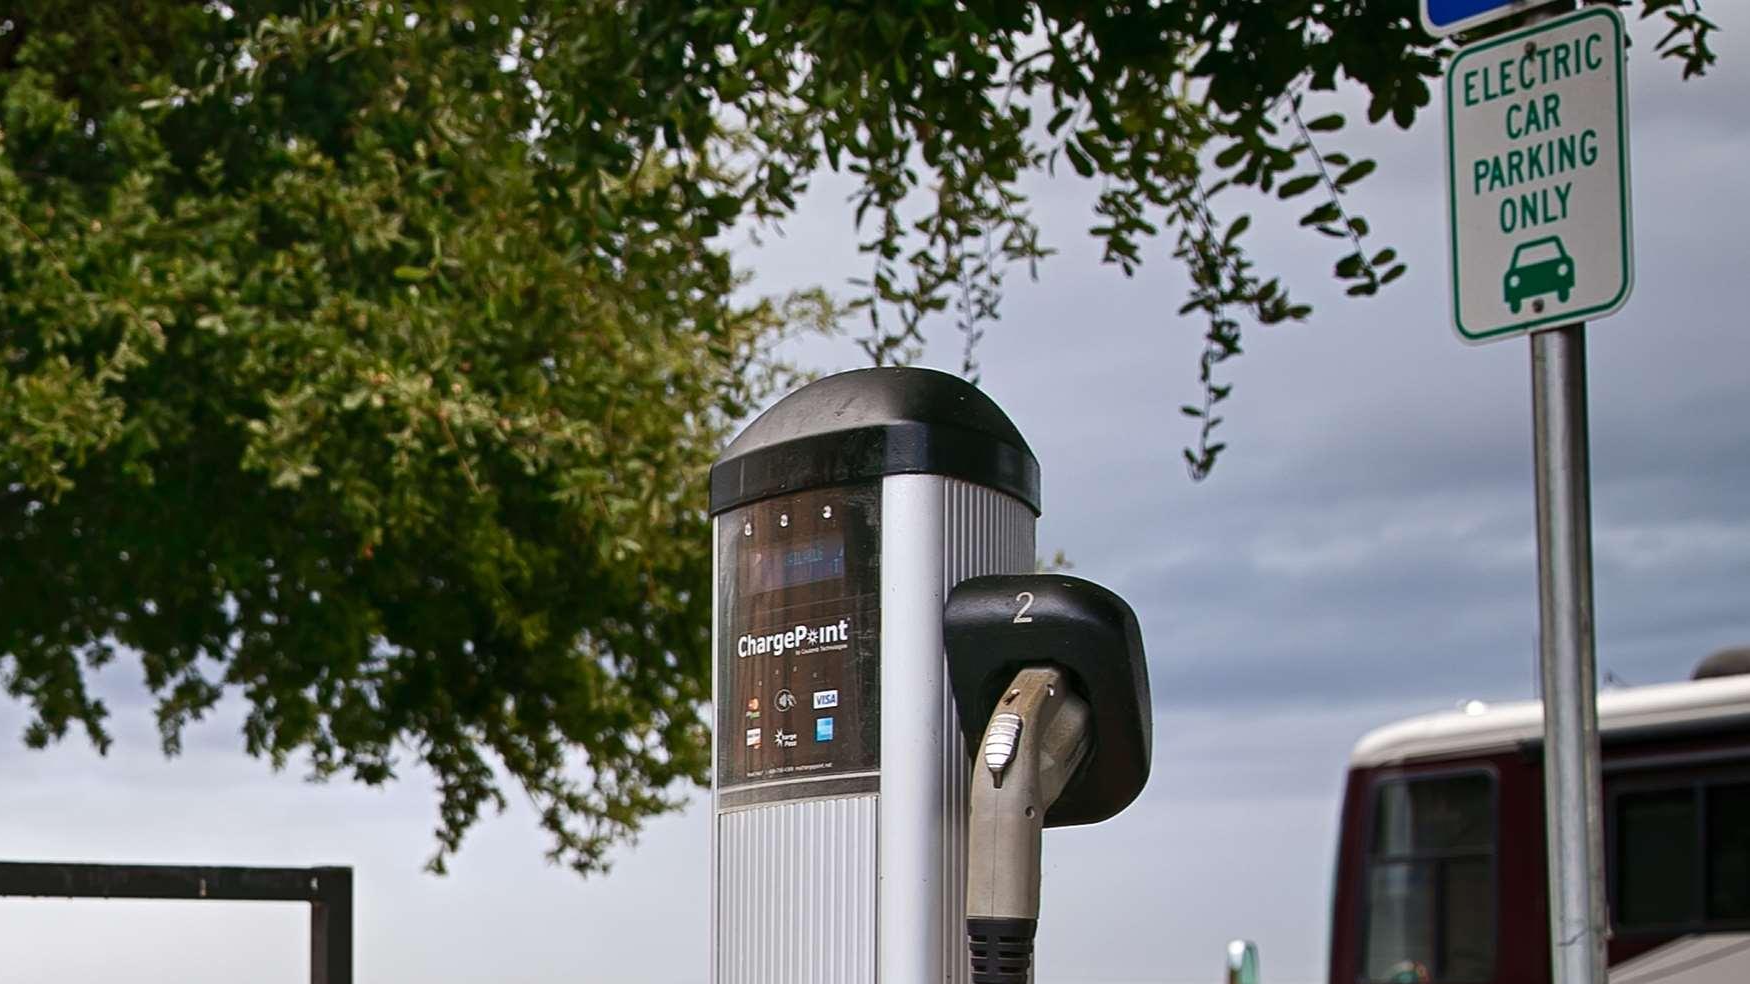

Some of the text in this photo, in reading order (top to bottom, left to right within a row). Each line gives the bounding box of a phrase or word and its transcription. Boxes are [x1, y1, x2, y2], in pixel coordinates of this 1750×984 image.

[1463, 33, 1602, 107] ELECTRIC
[1506, 93, 1561, 139] CAR
[1474, 129, 1598, 195] PARKING
[1500, 181, 1572, 234] ONLY
[1013, 591, 1034, 623] 2
[737, 619, 849, 658] ChargePoint
[816, 693, 836, 706] VISA
